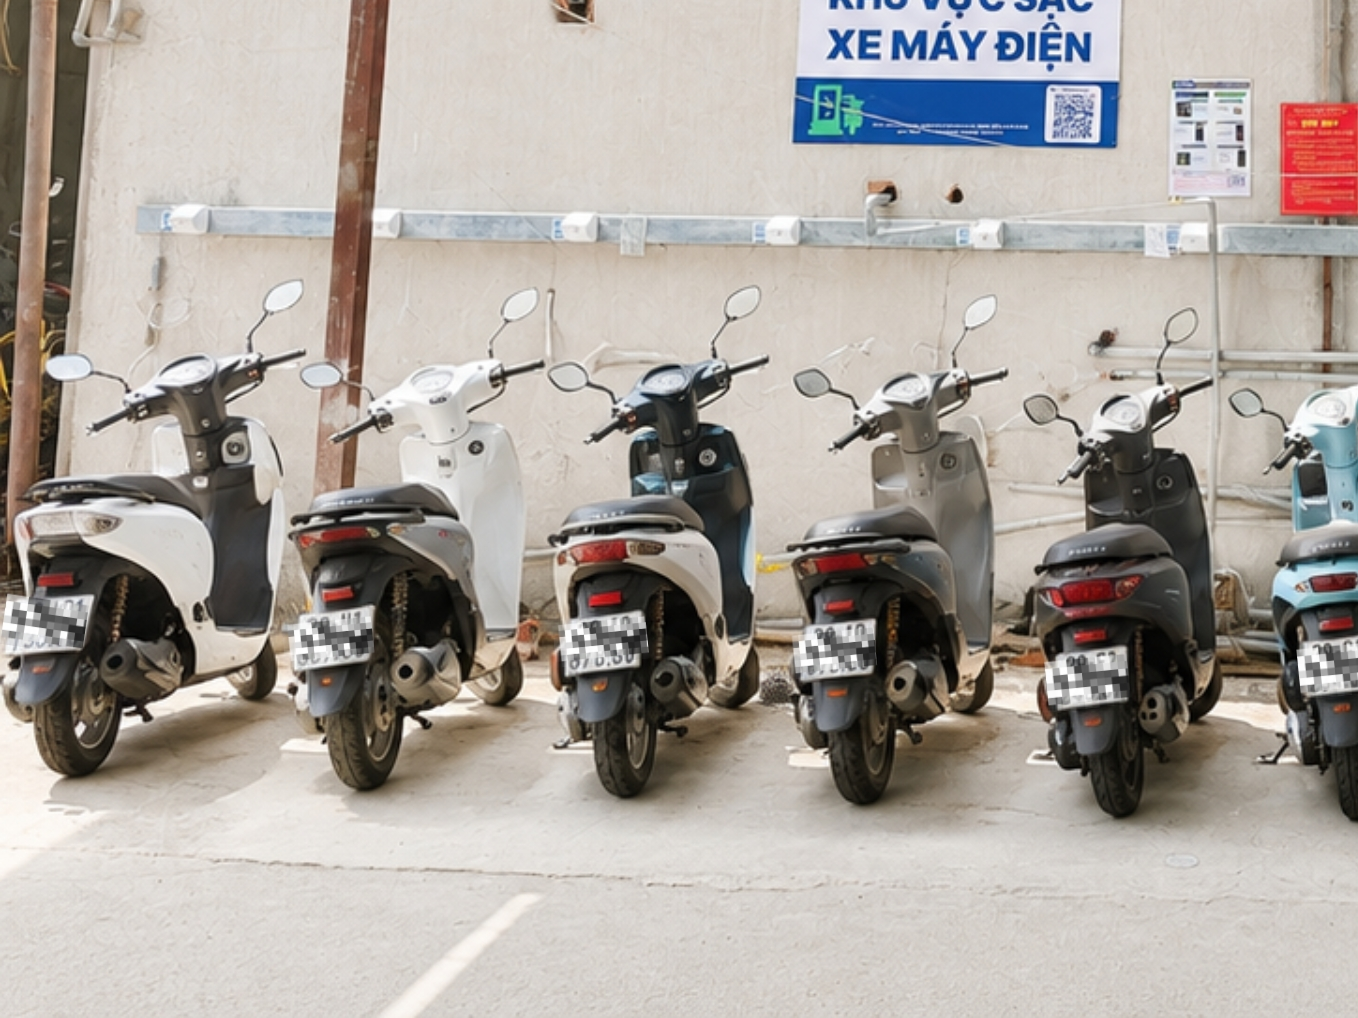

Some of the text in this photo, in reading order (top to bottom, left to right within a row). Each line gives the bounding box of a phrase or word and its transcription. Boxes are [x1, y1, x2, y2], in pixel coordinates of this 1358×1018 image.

[826, 20, 1091, 72] XE MÁY ĐIỆN
